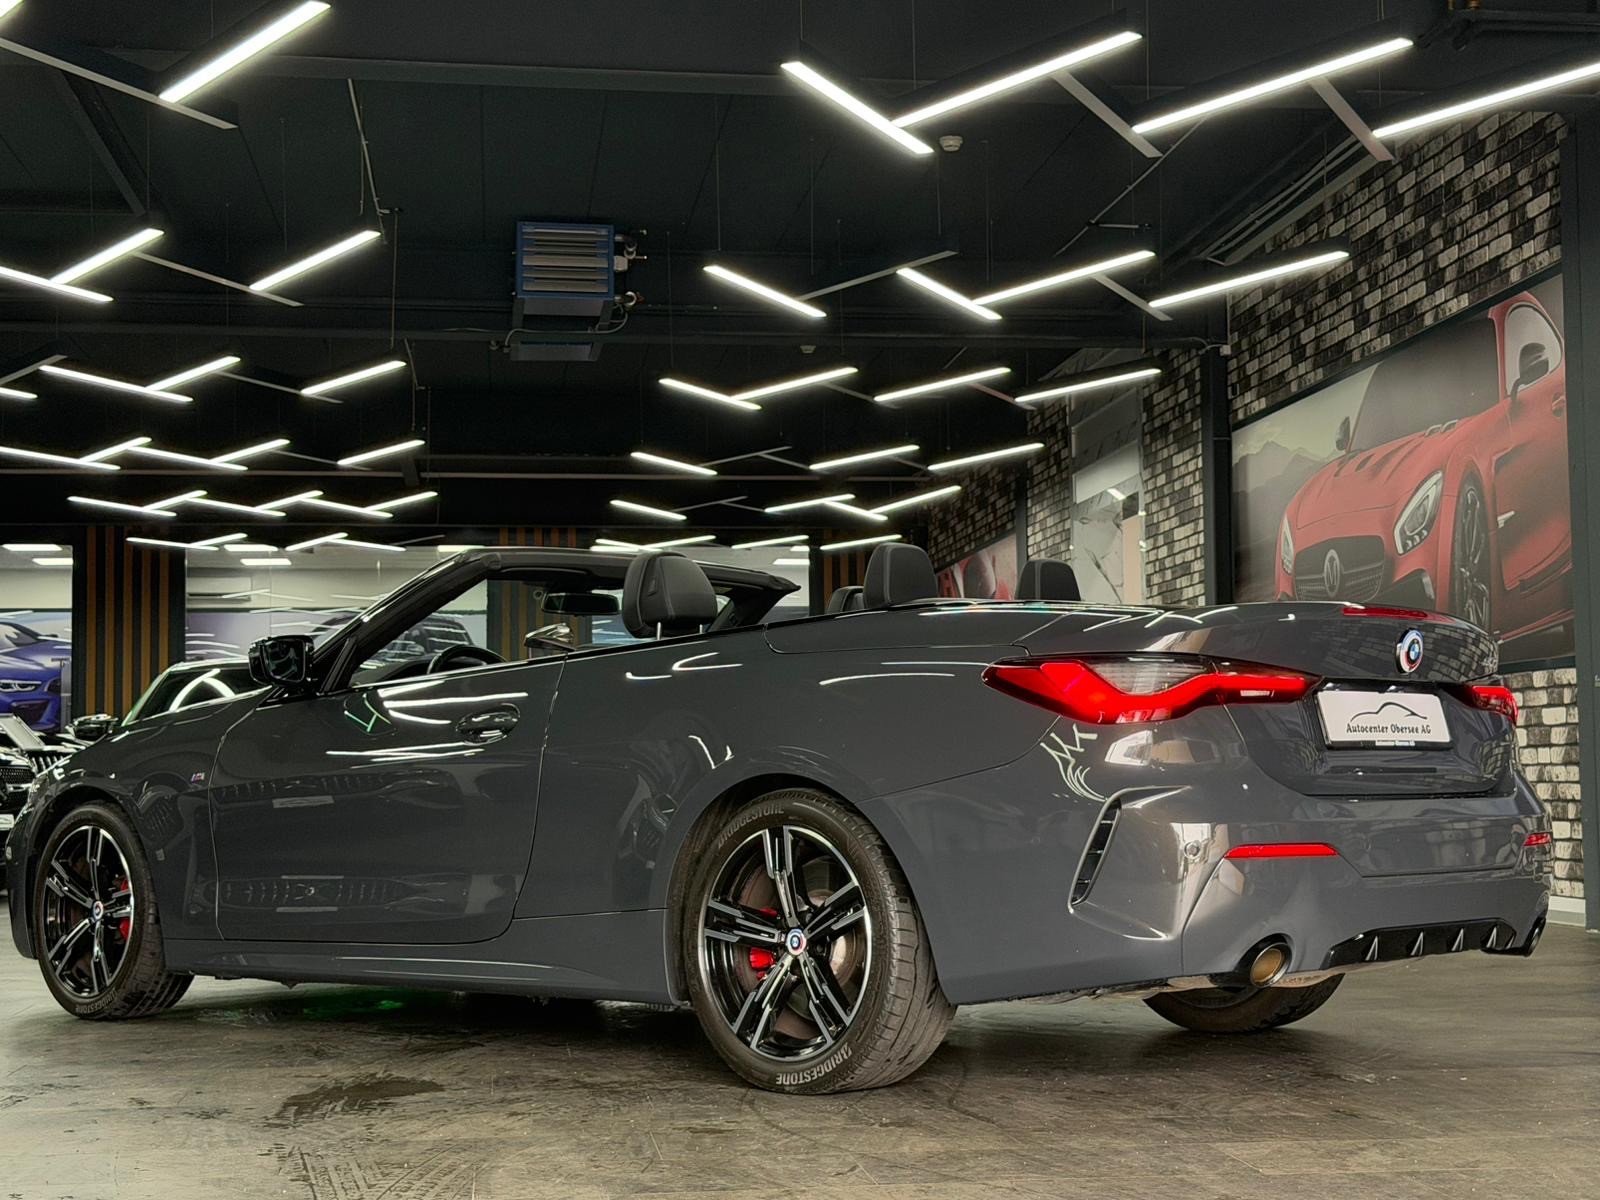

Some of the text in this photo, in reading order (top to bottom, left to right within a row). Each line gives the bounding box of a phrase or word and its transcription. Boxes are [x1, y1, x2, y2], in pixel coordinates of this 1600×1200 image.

[1346, 723, 1431, 734] Autocenter Obersee AG
[776, 1042, 853, 1085] BRIDGESTONE
